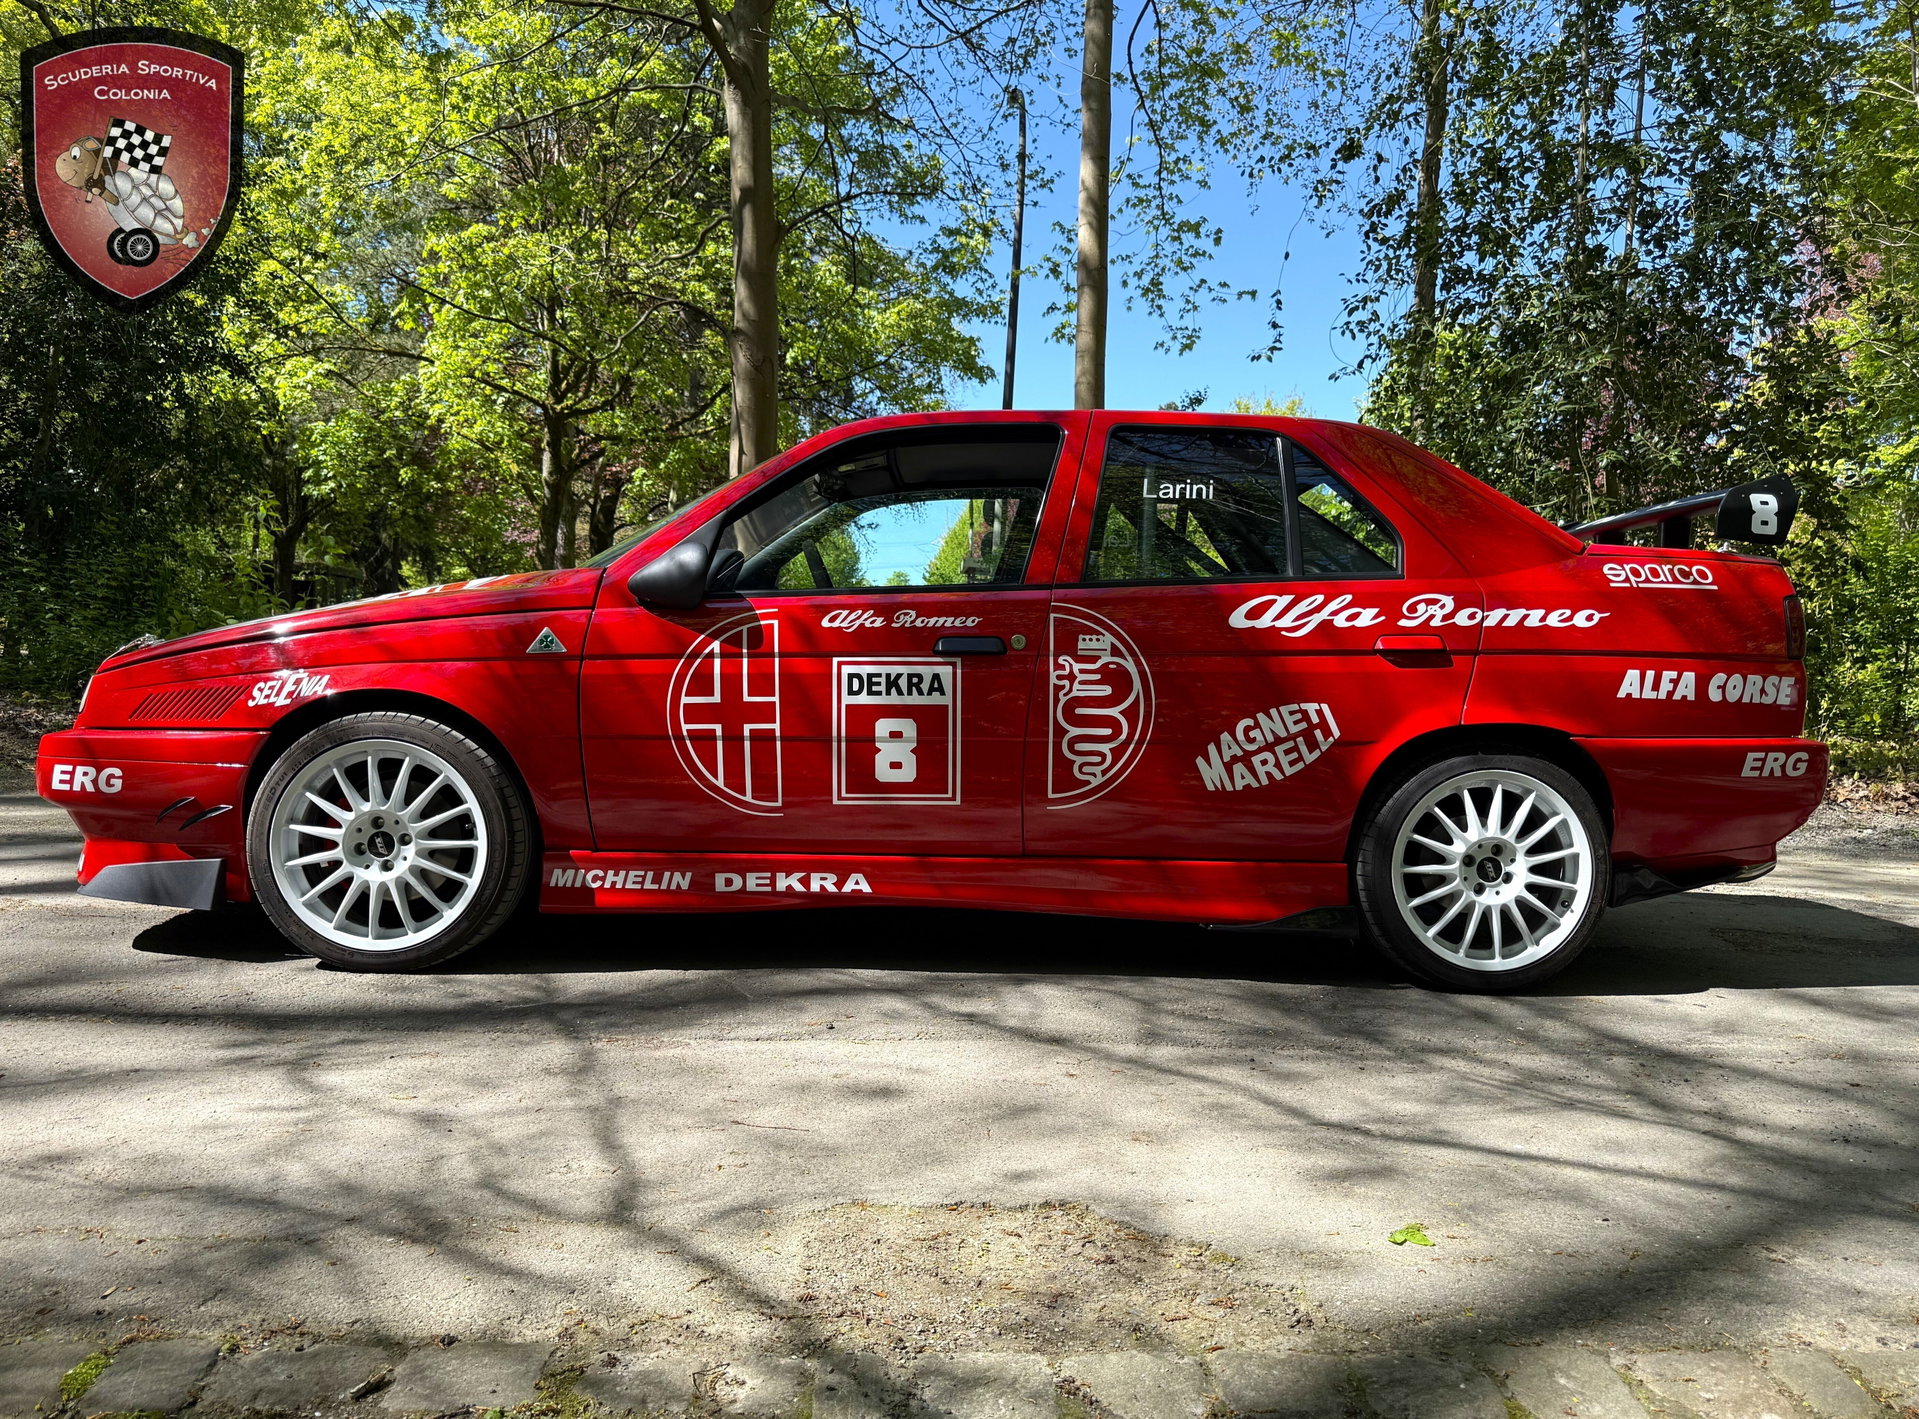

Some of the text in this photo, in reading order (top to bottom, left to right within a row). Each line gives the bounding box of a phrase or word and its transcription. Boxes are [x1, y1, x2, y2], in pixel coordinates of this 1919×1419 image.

[1143, 478, 1214, 500] Larini
[1749, 493, 1779, 535] 8
[1602, 563, 1715, 589] sparco
[821, 609, 983, 633] Alfa Romeo
[1228, 593, 1611, 638] Alfa Romeo
[247, 672, 331, 708] SELENIA
[846, 672, 947, 698] DEKRA
[1616, 669, 1796, 705] ALFA CORSE
[874, 718, 918, 783] 8
[1195, 702, 1341, 784] MAGNETI
[1740, 751, 1809, 777] ERG
[51, 763, 124, 794] ERG
[549, 868, 693, 890] MICHELIN
[714, 873, 873, 893] DEKRA
